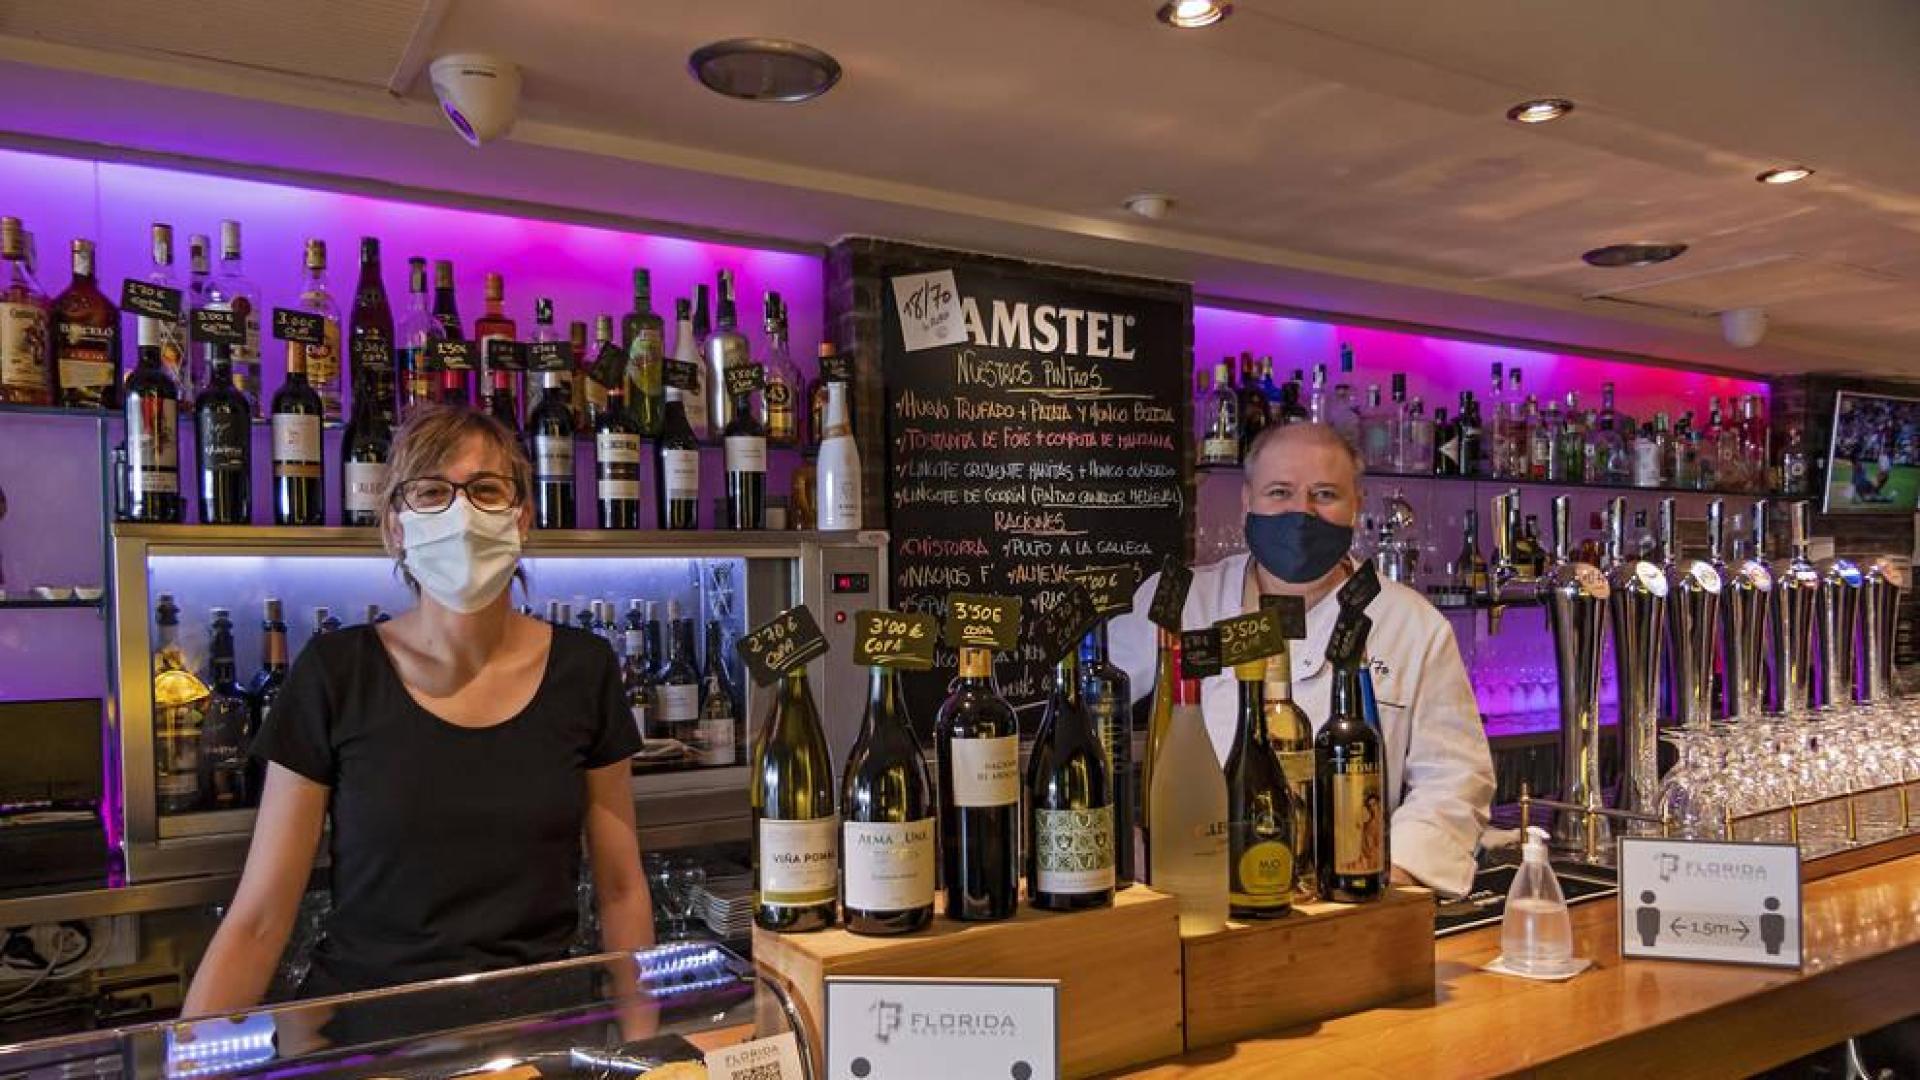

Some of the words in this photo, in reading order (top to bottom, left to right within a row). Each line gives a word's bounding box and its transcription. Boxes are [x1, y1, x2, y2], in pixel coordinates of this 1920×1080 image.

[962, 297, 1136, 360] AMSTEL
[982, 431, 999, 449] DE
[963, 487, 982, 504] DE
[910, 1013, 1015, 1029] FLORIDA
